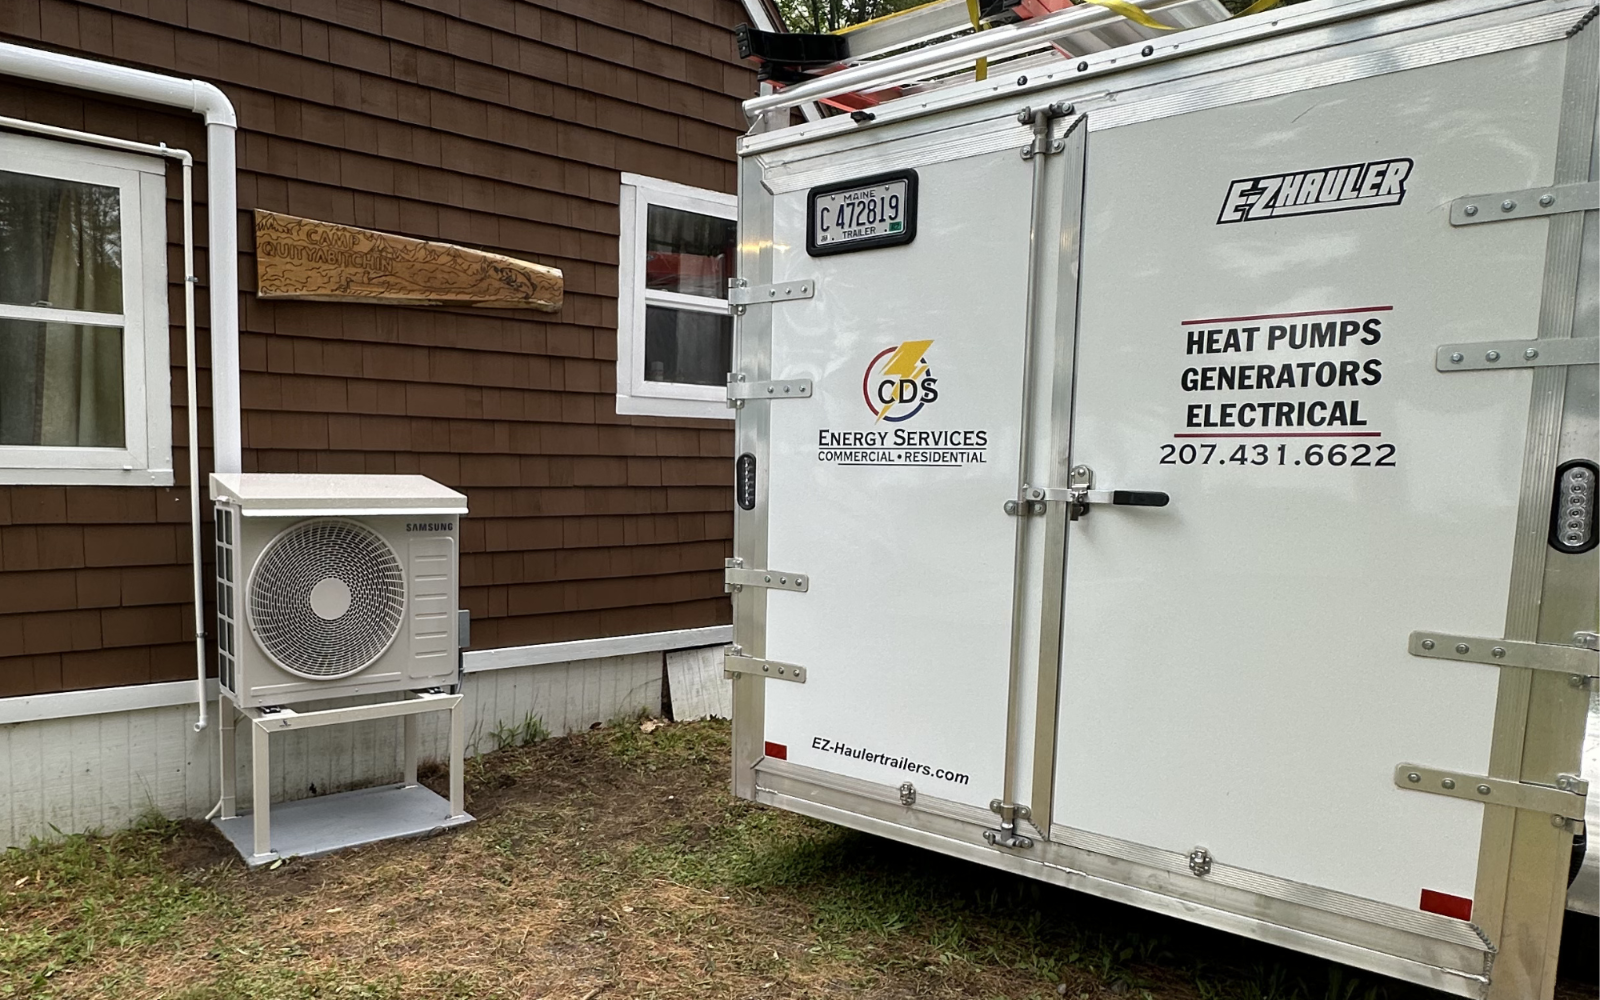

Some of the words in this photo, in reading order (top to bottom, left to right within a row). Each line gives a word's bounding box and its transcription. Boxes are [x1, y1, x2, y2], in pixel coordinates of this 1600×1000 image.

[843, 190, 876, 202] MAINE
[820, 207, 830, 232] C
[835, 194, 899, 229] 472819
[306, 229, 361, 249] CAMP
[842, 226, 876, 239] TRAILER
[1186, 327, 1260, 355] HEAT
[1267, 318, 1382, 350] PUMPS
[1181, 359, 1382, 391] GENERATORS
[877, 377, 939, 404] CDS
[1186, 400, 1368, 428] ELECTRICAL
[818, 429, 889, 446] ENERGY
[893, 428, 988, 447] SERVICES
[1159, 443, 1397, 467] 207.431.6622
[406, 522, 453, 532] SAMSUNG
[811, 736, 969, 785] EZ-Haulertrailers.com
